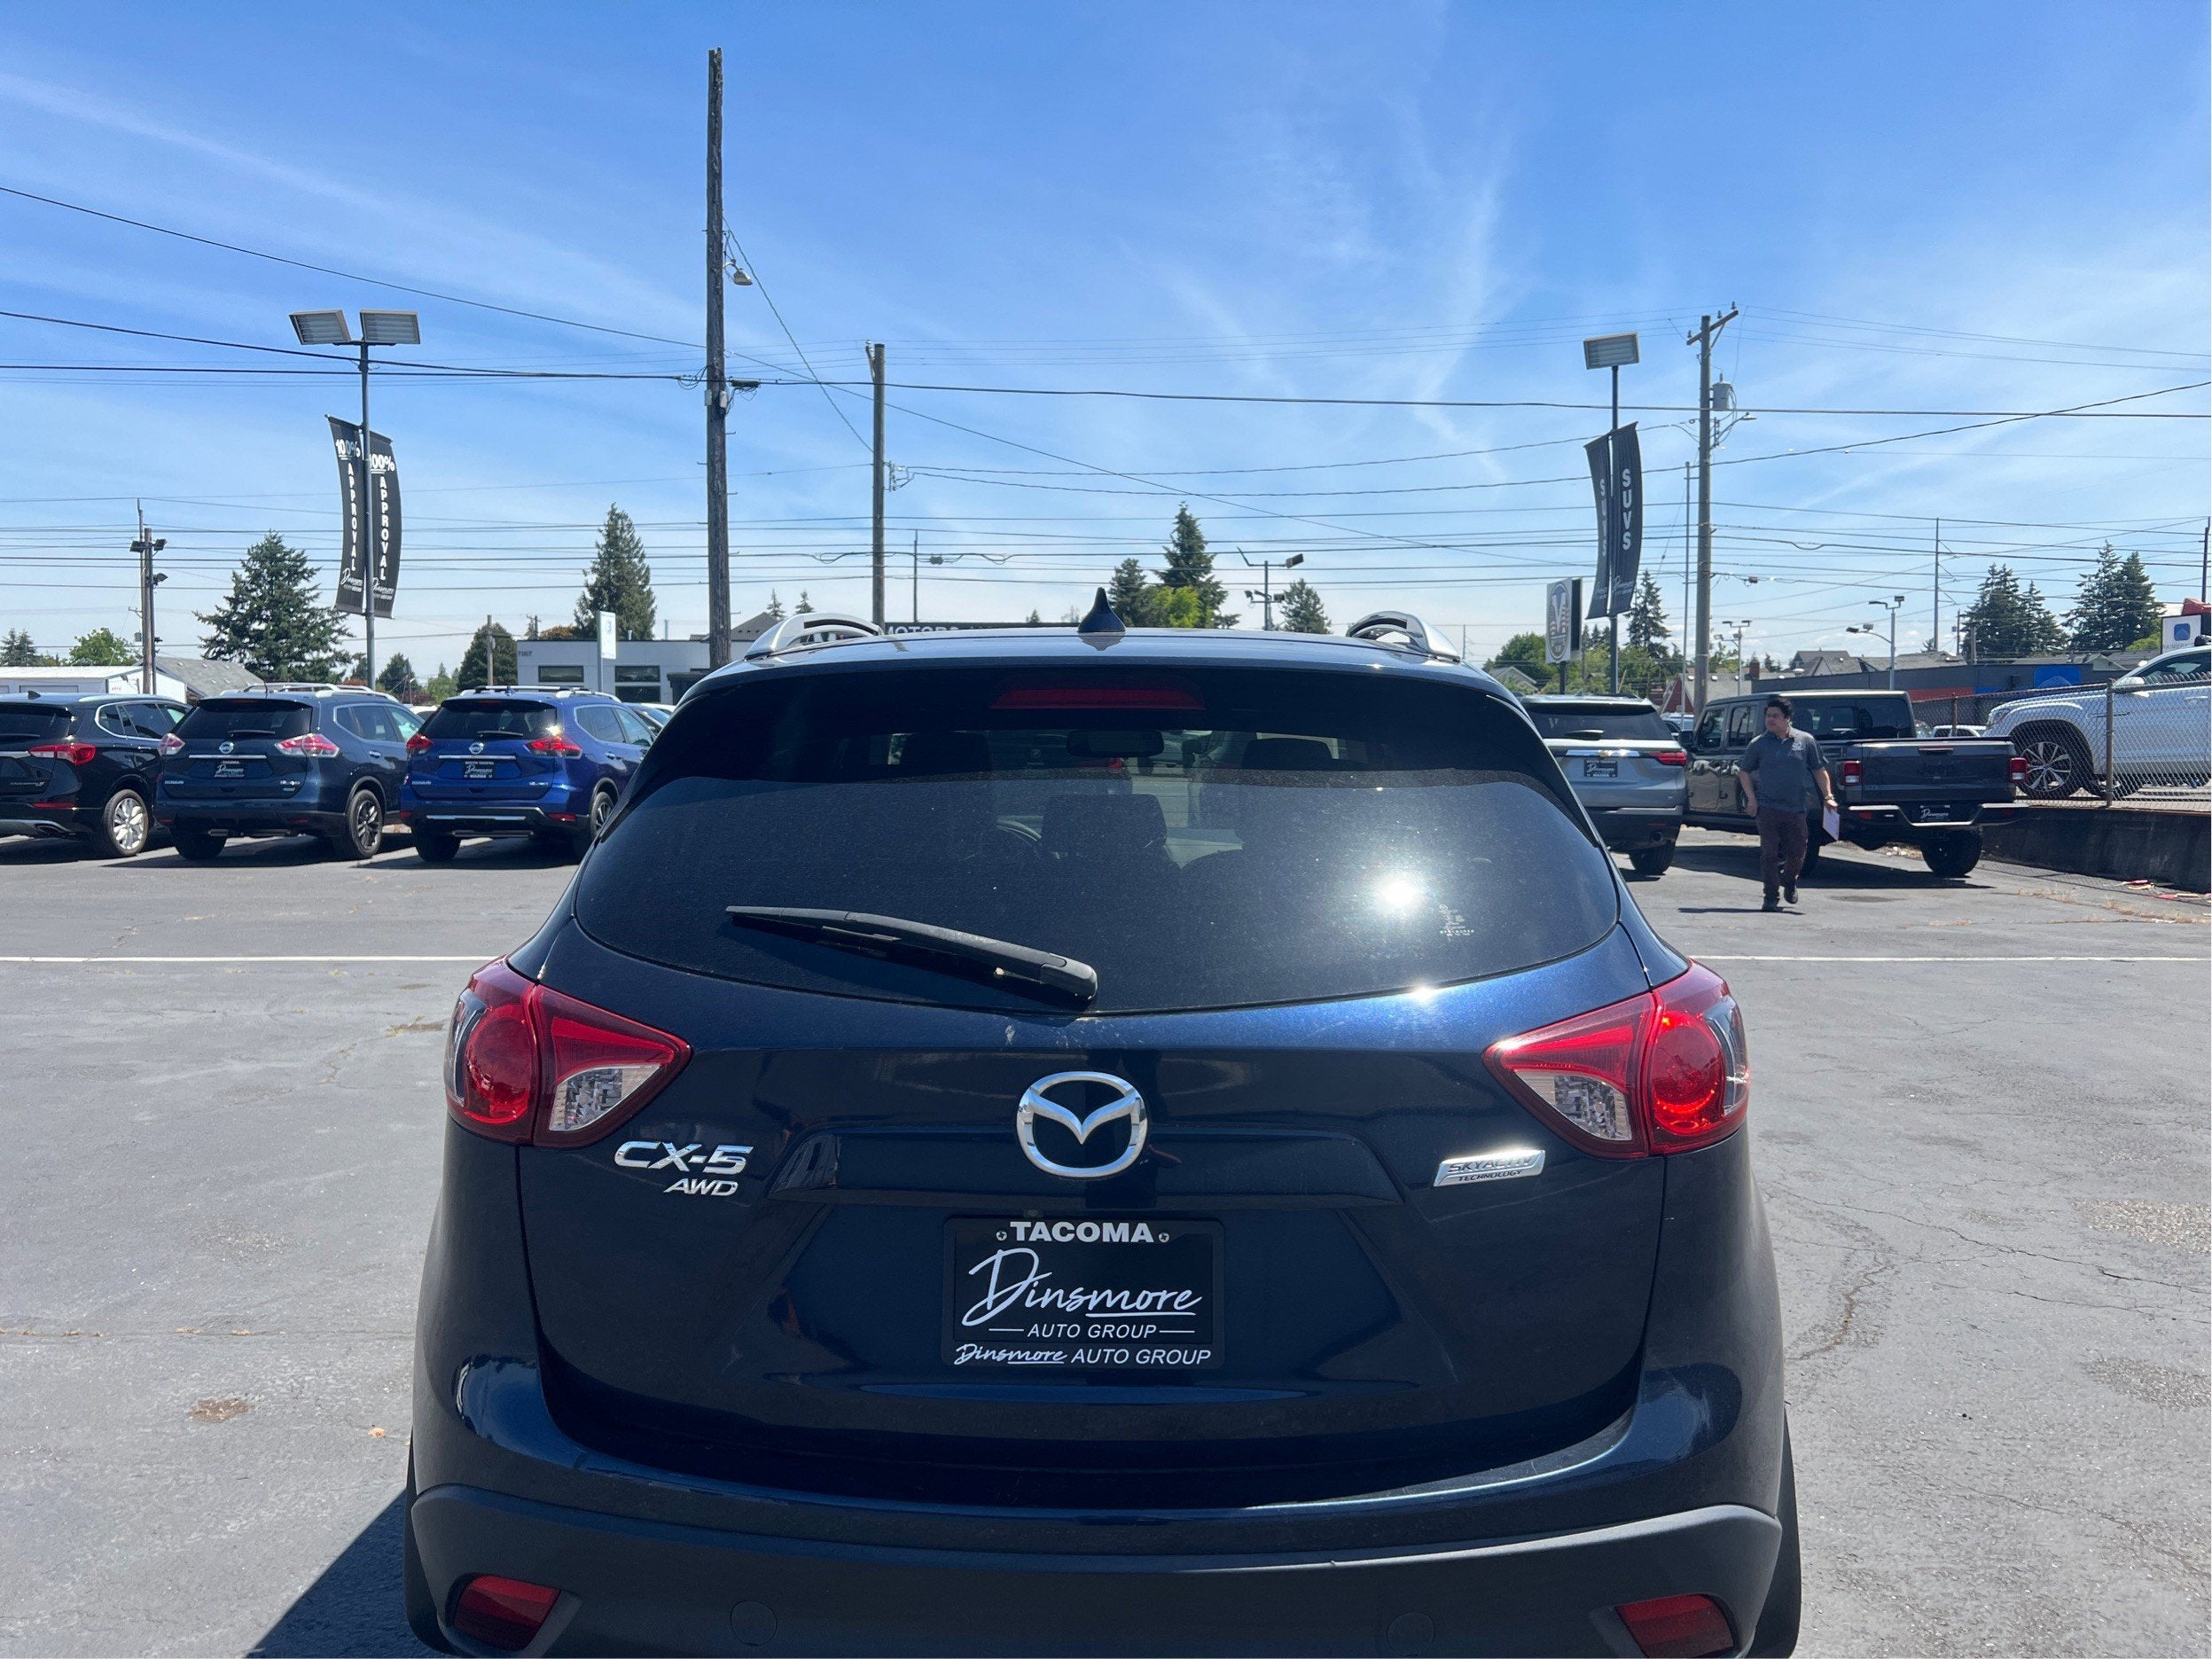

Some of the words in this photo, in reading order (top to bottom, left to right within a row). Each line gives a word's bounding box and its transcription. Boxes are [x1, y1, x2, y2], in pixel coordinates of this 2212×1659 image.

[347, 462, 357, 572] APPROVAL
[1622, 468, 1633, 552] SUVS
[379, 475, 389, 581] APPROVAL
[614, 1140, 754, 1175] CX-5
[663, 1178, 739, 1196] AWD
[1458, 1169, 1524, 1182] TECHNOLOGY
[1010, 1221, 1154, 1243] TACOMA
[962, 1248, 1202, 1326] Dinsmore
[1027, 1324, 1081, 1338] AUTO
[1087, 1324, 1157, 1339] GROUP
[954, 1343, 1067, 1366] Dinsmore
[1070, 1349, 1130, 1365] AUTO
[1135, 1350, 1211, 1365] GROUP
